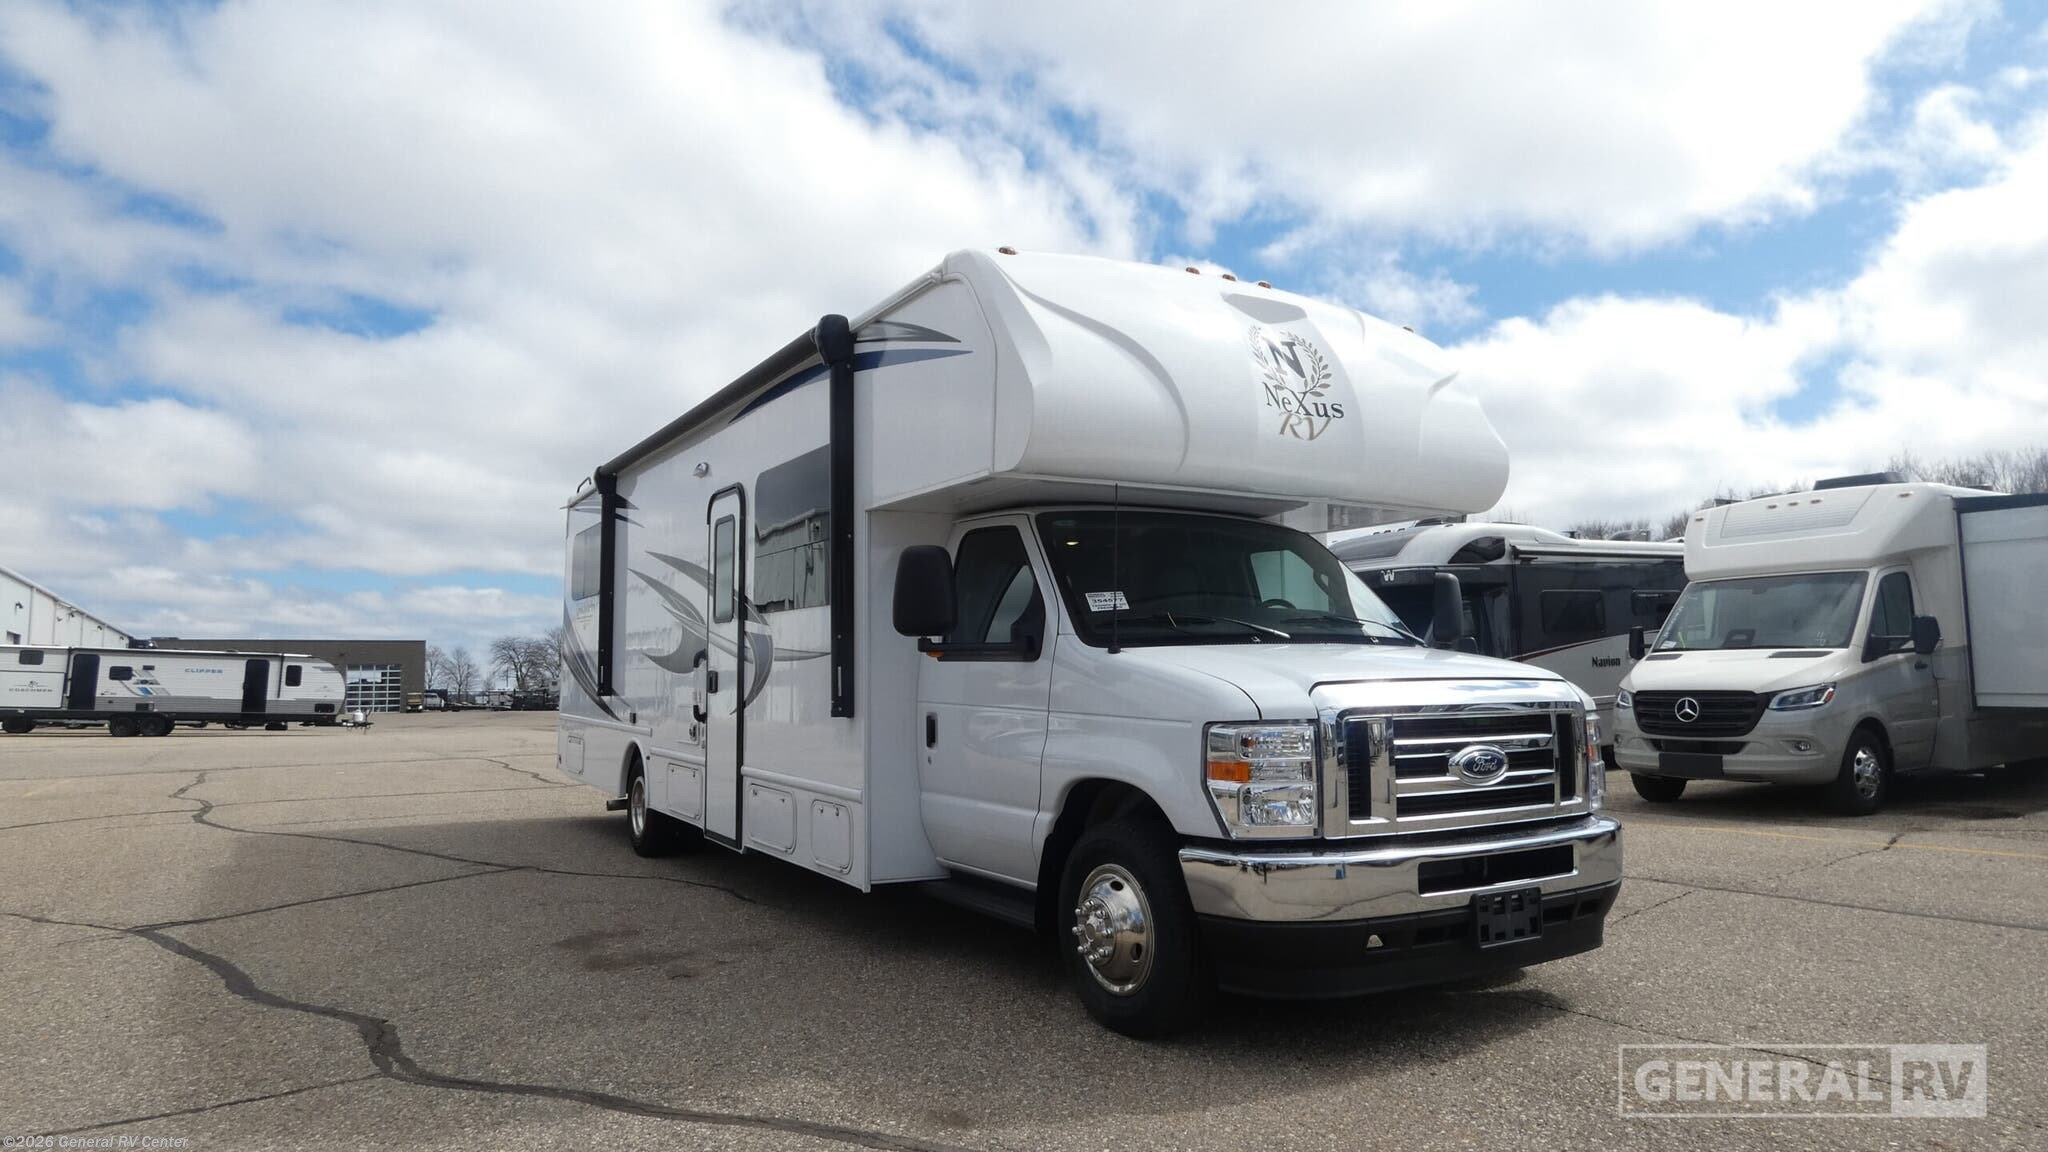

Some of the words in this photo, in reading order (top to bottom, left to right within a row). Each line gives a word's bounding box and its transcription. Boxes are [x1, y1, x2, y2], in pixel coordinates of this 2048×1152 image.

[1262, 381, 1345, 419] NeXus
[1279, 412, 1332, 441] RV
[1592, 656, 1621, 668] Navion
[1473, 755, 1498, 772] Ford
